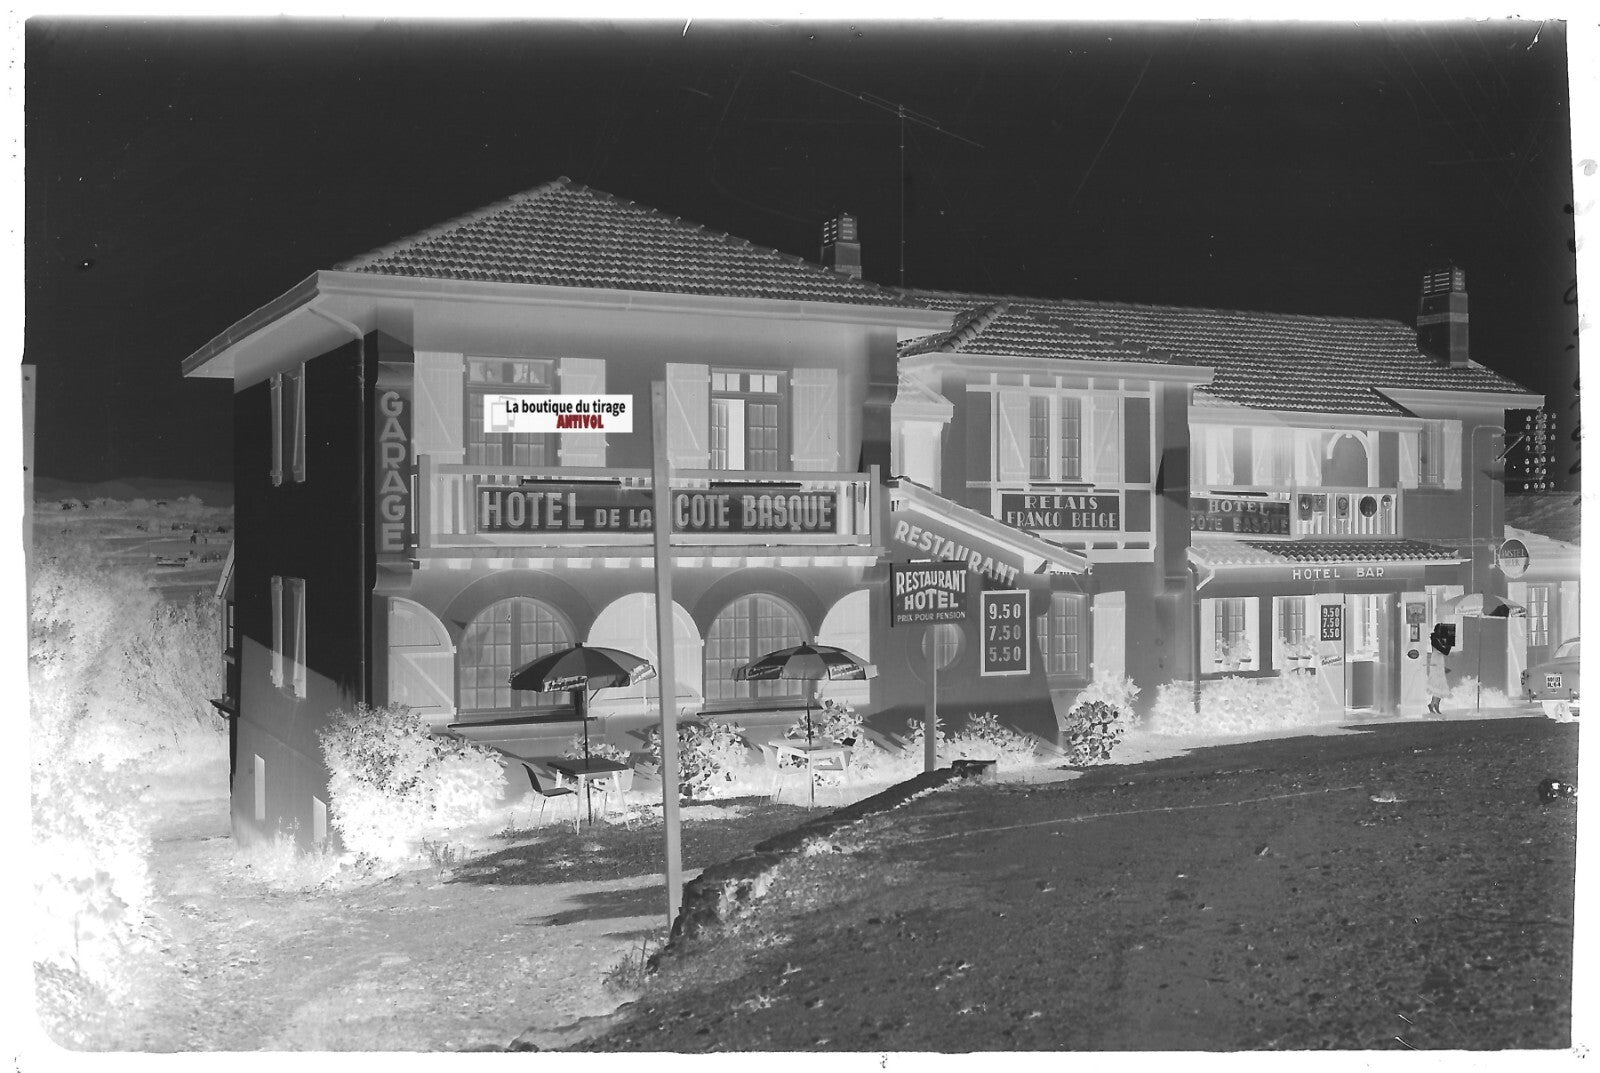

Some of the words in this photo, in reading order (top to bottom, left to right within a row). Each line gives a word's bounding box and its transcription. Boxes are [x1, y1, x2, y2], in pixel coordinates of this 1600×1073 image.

[379, 391, 408, 551] GARAGE
[1024, 495, 1099, 510] RELAIS
[1208, 499, 1270, 516] HOTEL
[481, 491, 585, 528] HOTEL
[595, 508, 621, 527] DE
[629, 508, 652, 527] LA
[676, 493, 730, 528] COTE
[742, 494, 832, 532] BASQUE
[1006, 510, 1062, 528] FRANCO
[1072, 512, 1118, 529] BELGE
[893, 520, 1020, 587] RESTAURANT
[1293, 569, 1340, 580] HOTEL
[1356, 567, 1385, 578] BAR
[896, 569, 967, 597] RESTAURANT
[904, 588, 959, 611] HOTEL
[897, 614, 913, 622] PRIX
[914, 613, 934, 621] POUR
[936, 611, 966, 620] PENSION
[988, 603, 1022, 620] 9.50
[1322, 607, 1340, 617] 9.50
[1322, 618, 1340, 628] 7.50
[988, 625, 1022, 642] 7.50
[1322, 628, 1340, 638] 5.50
[988, 646, 1022, 663] 5.50
